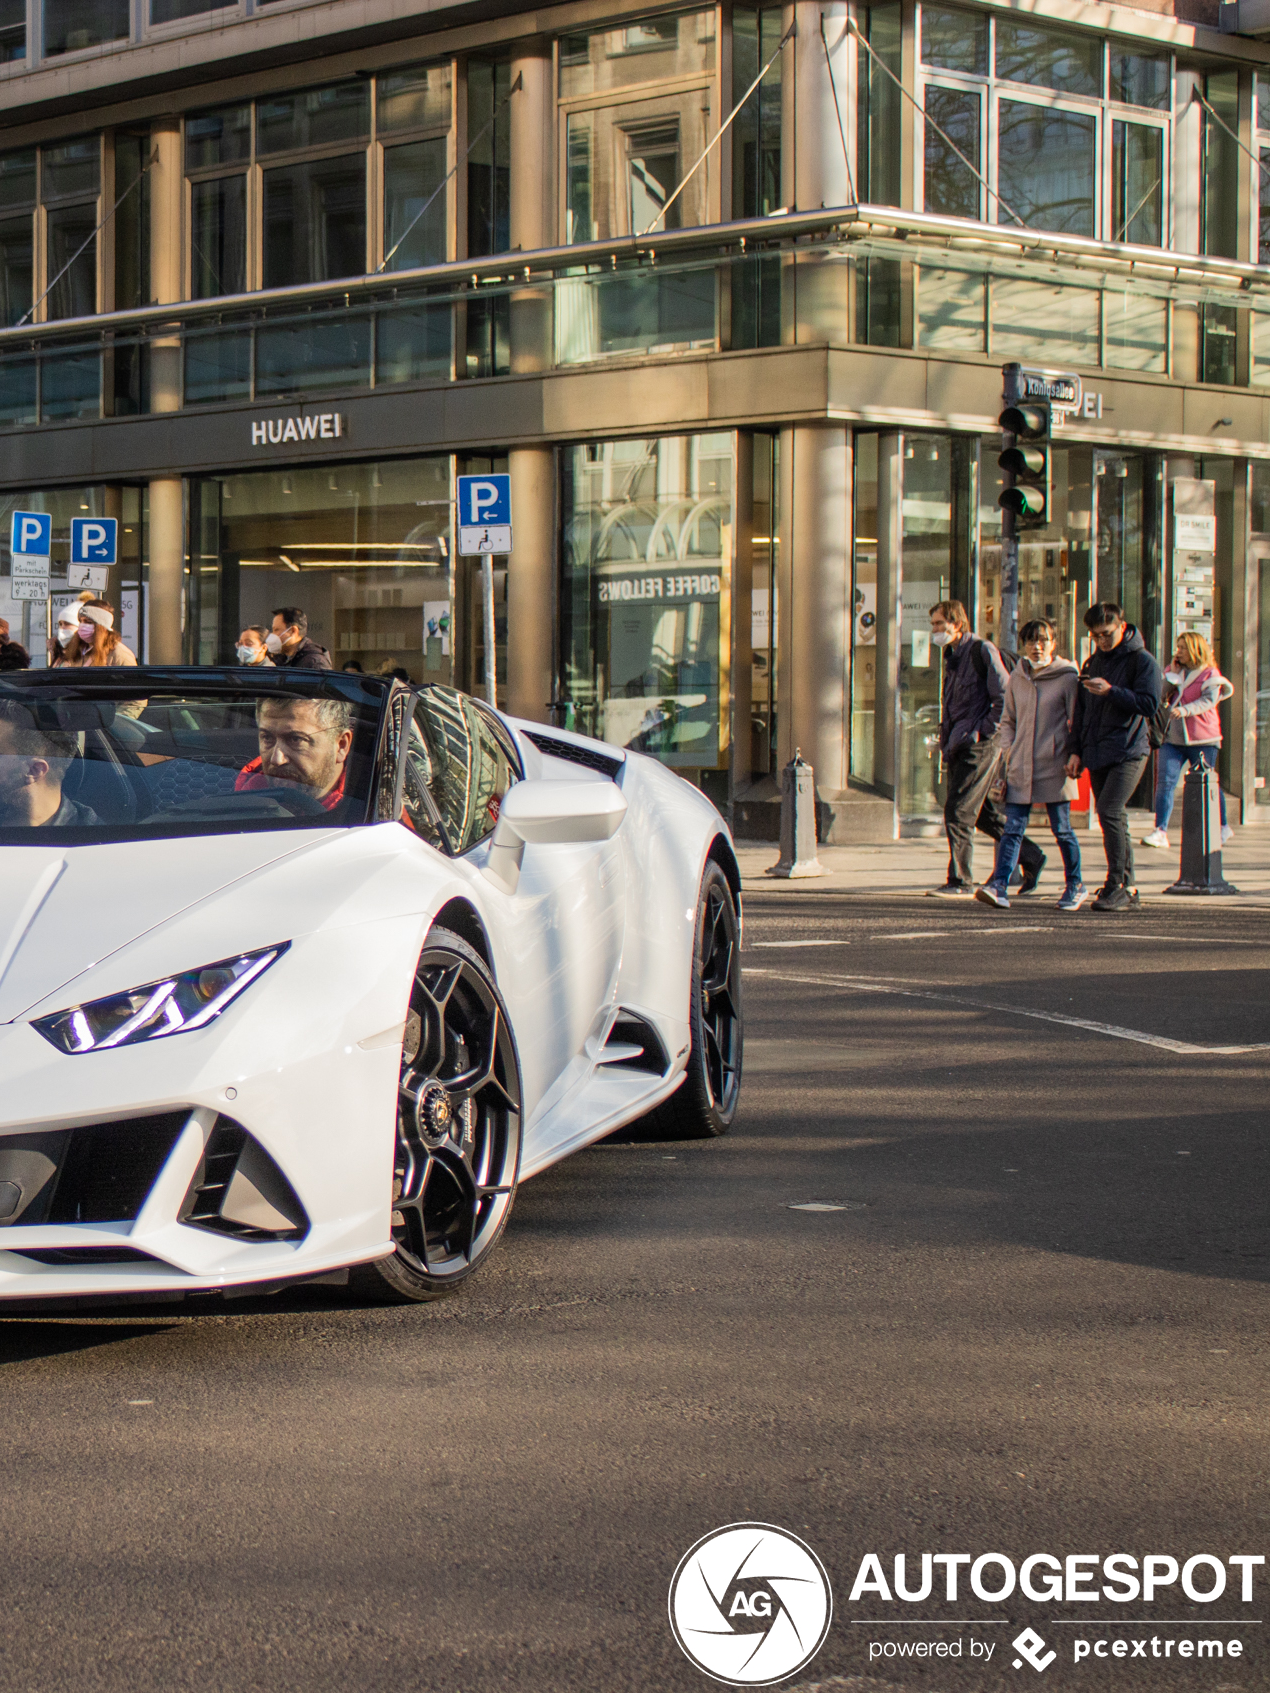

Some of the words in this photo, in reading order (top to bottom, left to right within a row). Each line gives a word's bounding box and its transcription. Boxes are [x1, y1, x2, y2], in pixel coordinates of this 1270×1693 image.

[252, 412, 341, 446] HUAWEI
[471, 482, 499, 523] P
[20, 517, 43, 552] P
[81, 523, 107, 559] P
[14, 580, 48, 589] werktags
[29, 589, 39, 598] 20
